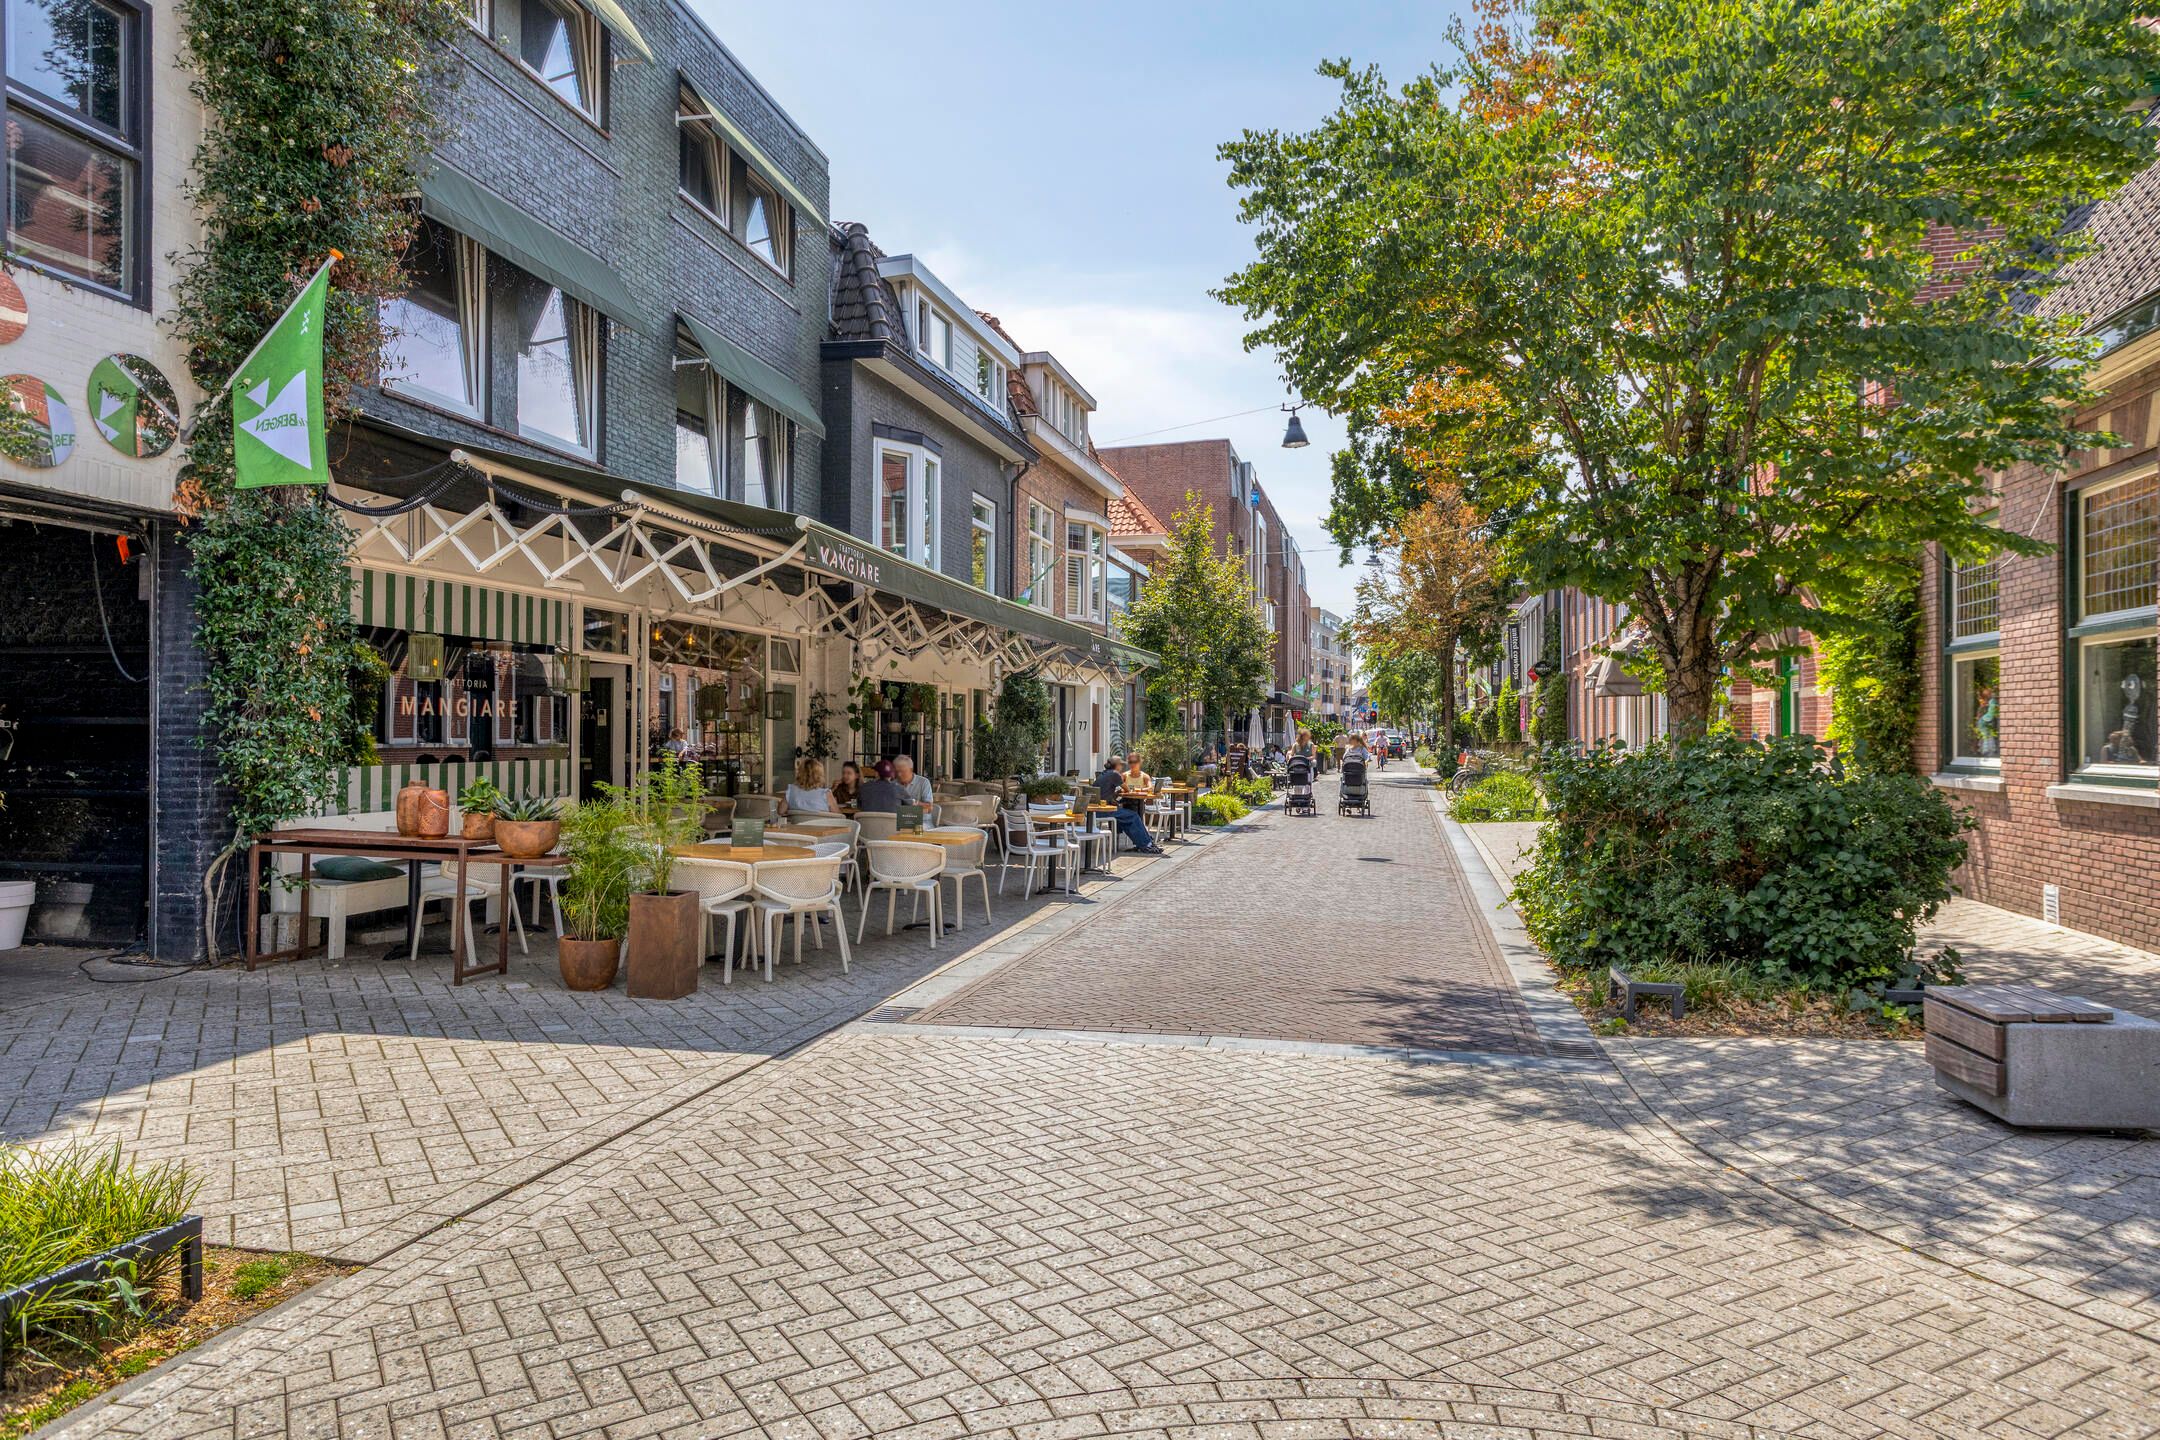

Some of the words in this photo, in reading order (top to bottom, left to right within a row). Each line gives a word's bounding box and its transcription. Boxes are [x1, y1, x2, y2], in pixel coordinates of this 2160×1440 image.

[1512, 650, 1521, 680] cowboys
[401, 696, 518, 718] MANGIARE
[1078, 720, 1088, 731] 77
